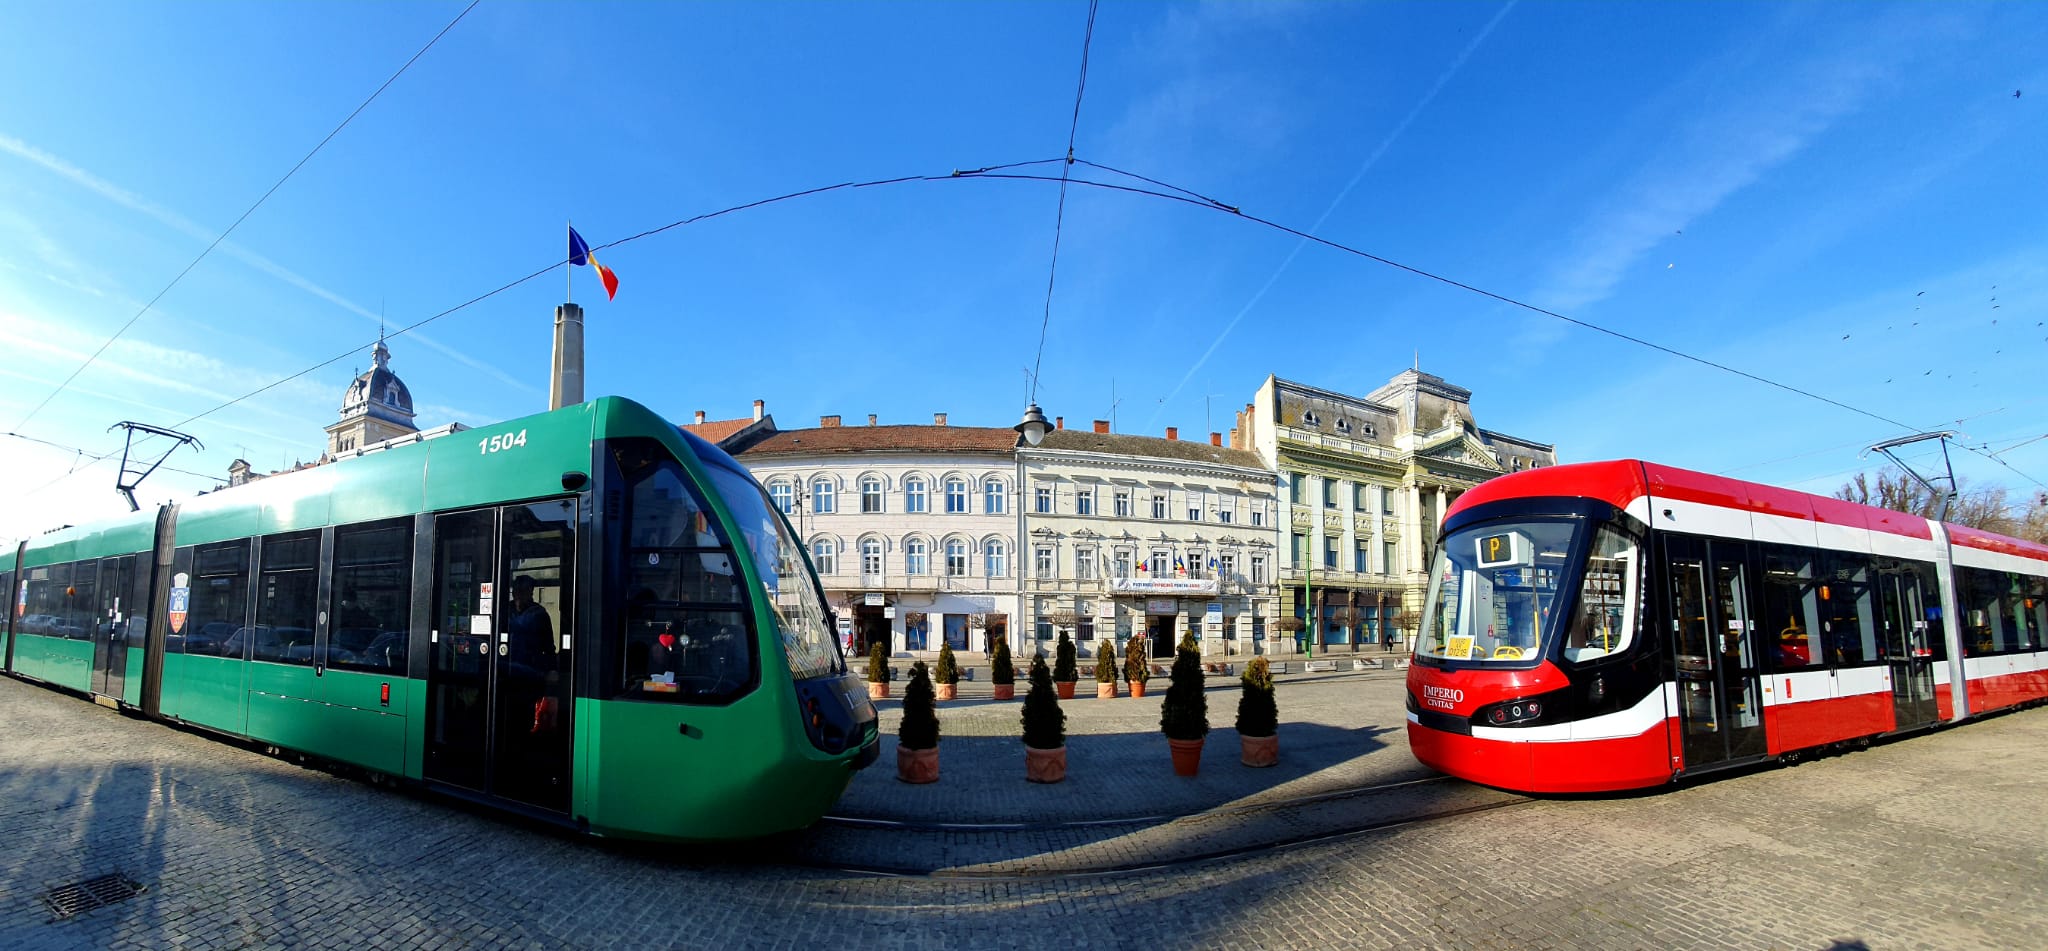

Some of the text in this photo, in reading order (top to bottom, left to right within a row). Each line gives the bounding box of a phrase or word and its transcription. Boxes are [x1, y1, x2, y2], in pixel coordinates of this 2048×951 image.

[479, 429, 527, 455] 1504
[1490, 537, 1500, 561] P
[1423, 685, 1464, 703] IMPERIO
[1427, 698, 1454, 710] CIVITAS
